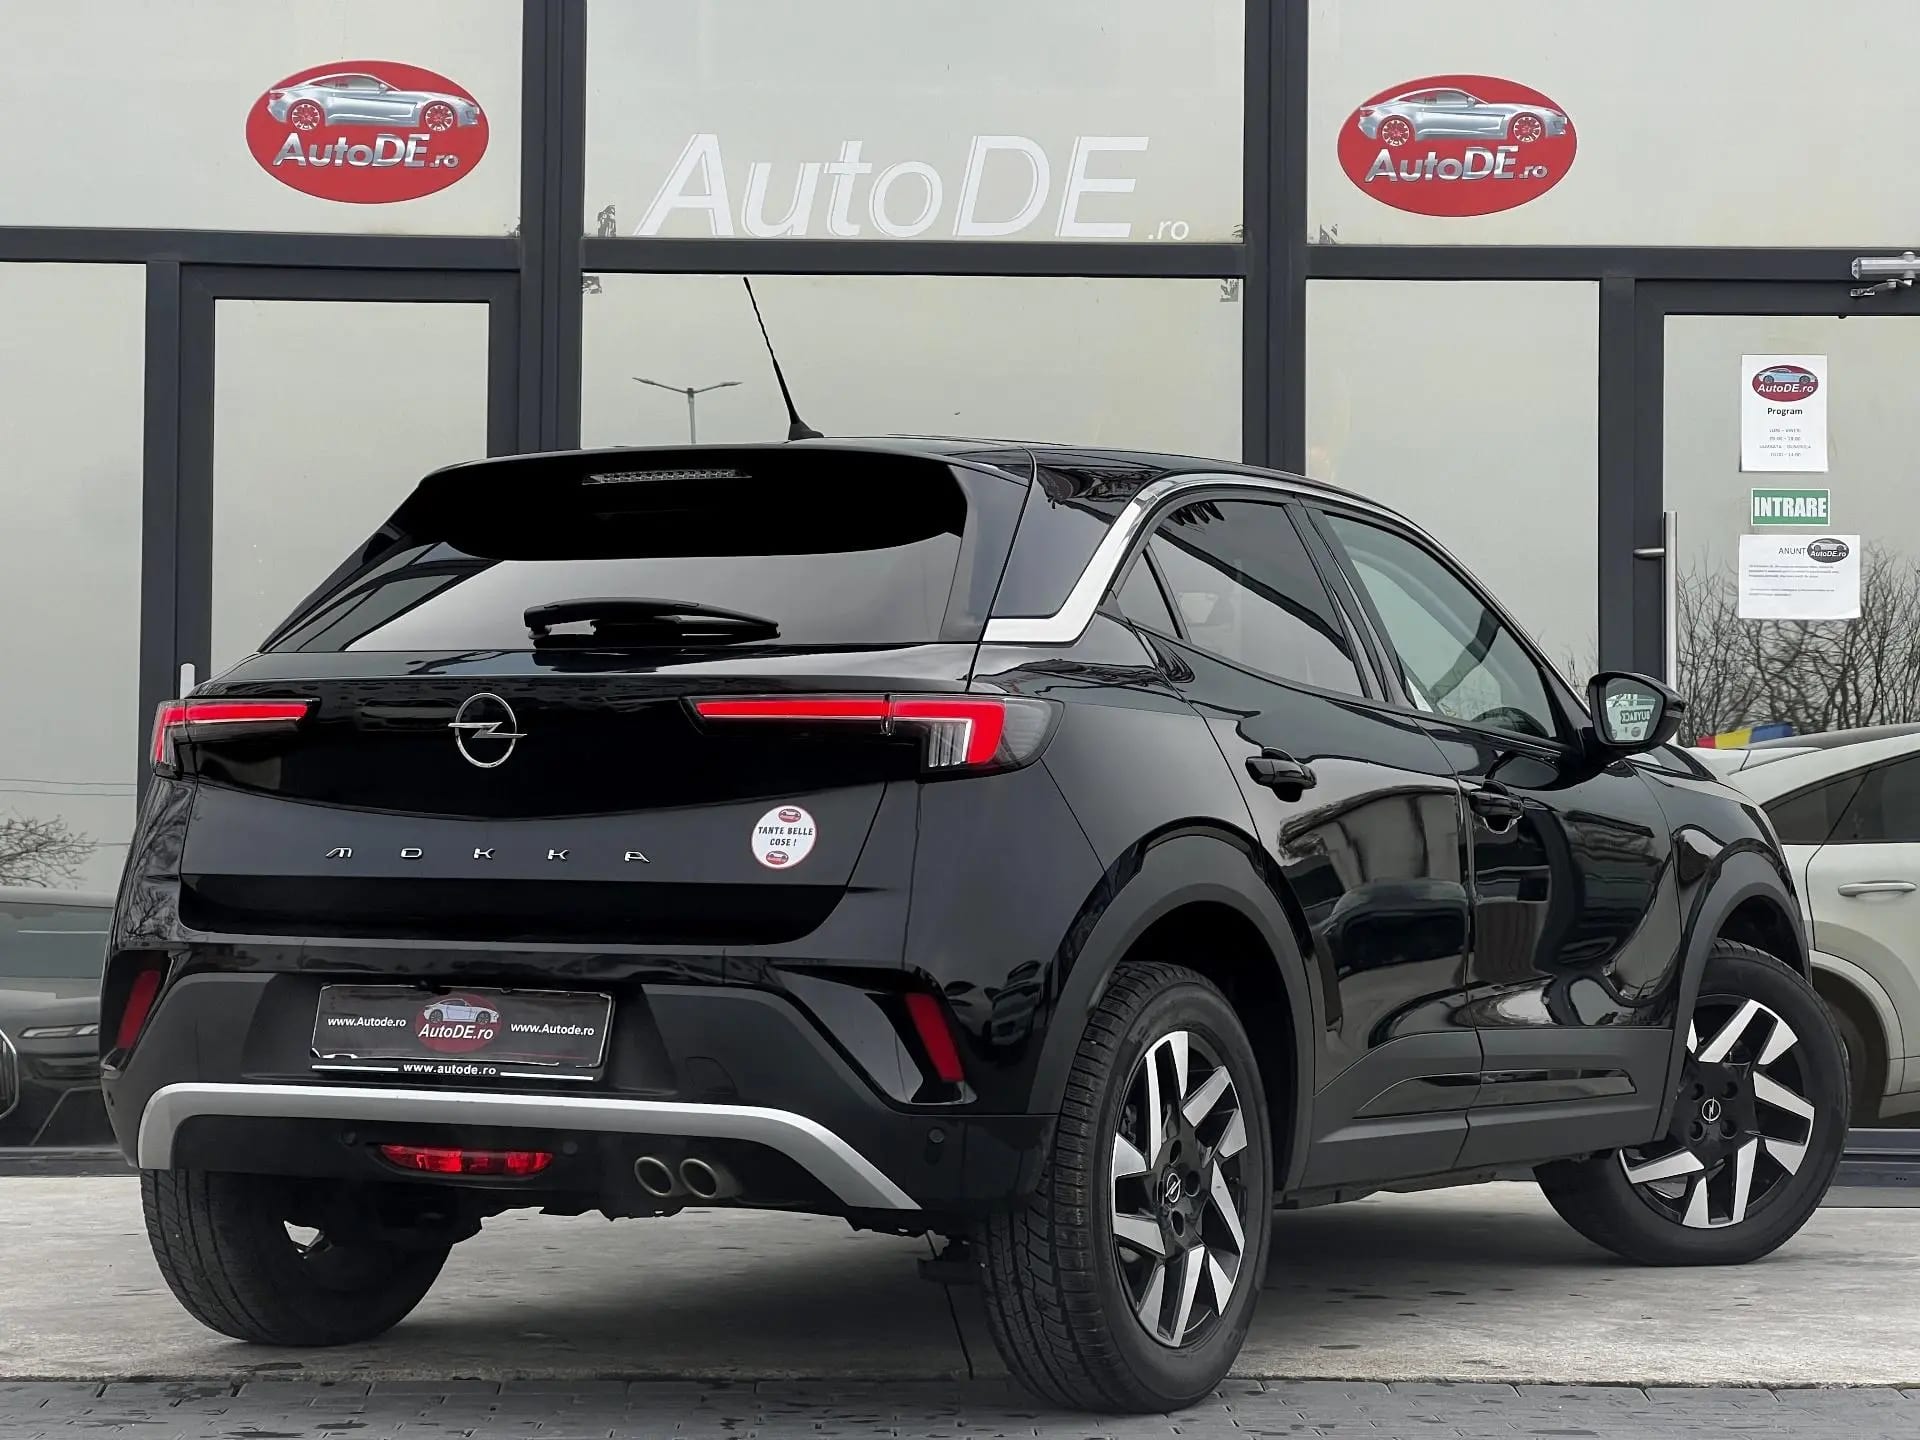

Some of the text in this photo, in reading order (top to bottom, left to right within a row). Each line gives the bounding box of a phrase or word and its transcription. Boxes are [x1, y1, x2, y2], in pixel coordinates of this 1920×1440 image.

[272, 132, 460, 168] AutoDE.ro
[1364, 145, 1549, 183] AutoDE.ro
[1757, 383, 1814, 393] AutoDE.ro
[1767, 407, 1803, 416] Program
[1754, 497, 1827, 517] INTRARE
[787, 827, 813, 835] BELLE
[326, 847, 651, 864] MOKKA
[327, 1016, 407, 1028] www.Autode.ro
[510, 1022, 595, 1037] www.Autode.ro
[418, 1023, 494, 1040] AutoDE.ro
[403, 1062, 497, 1076] www.autode.ro
